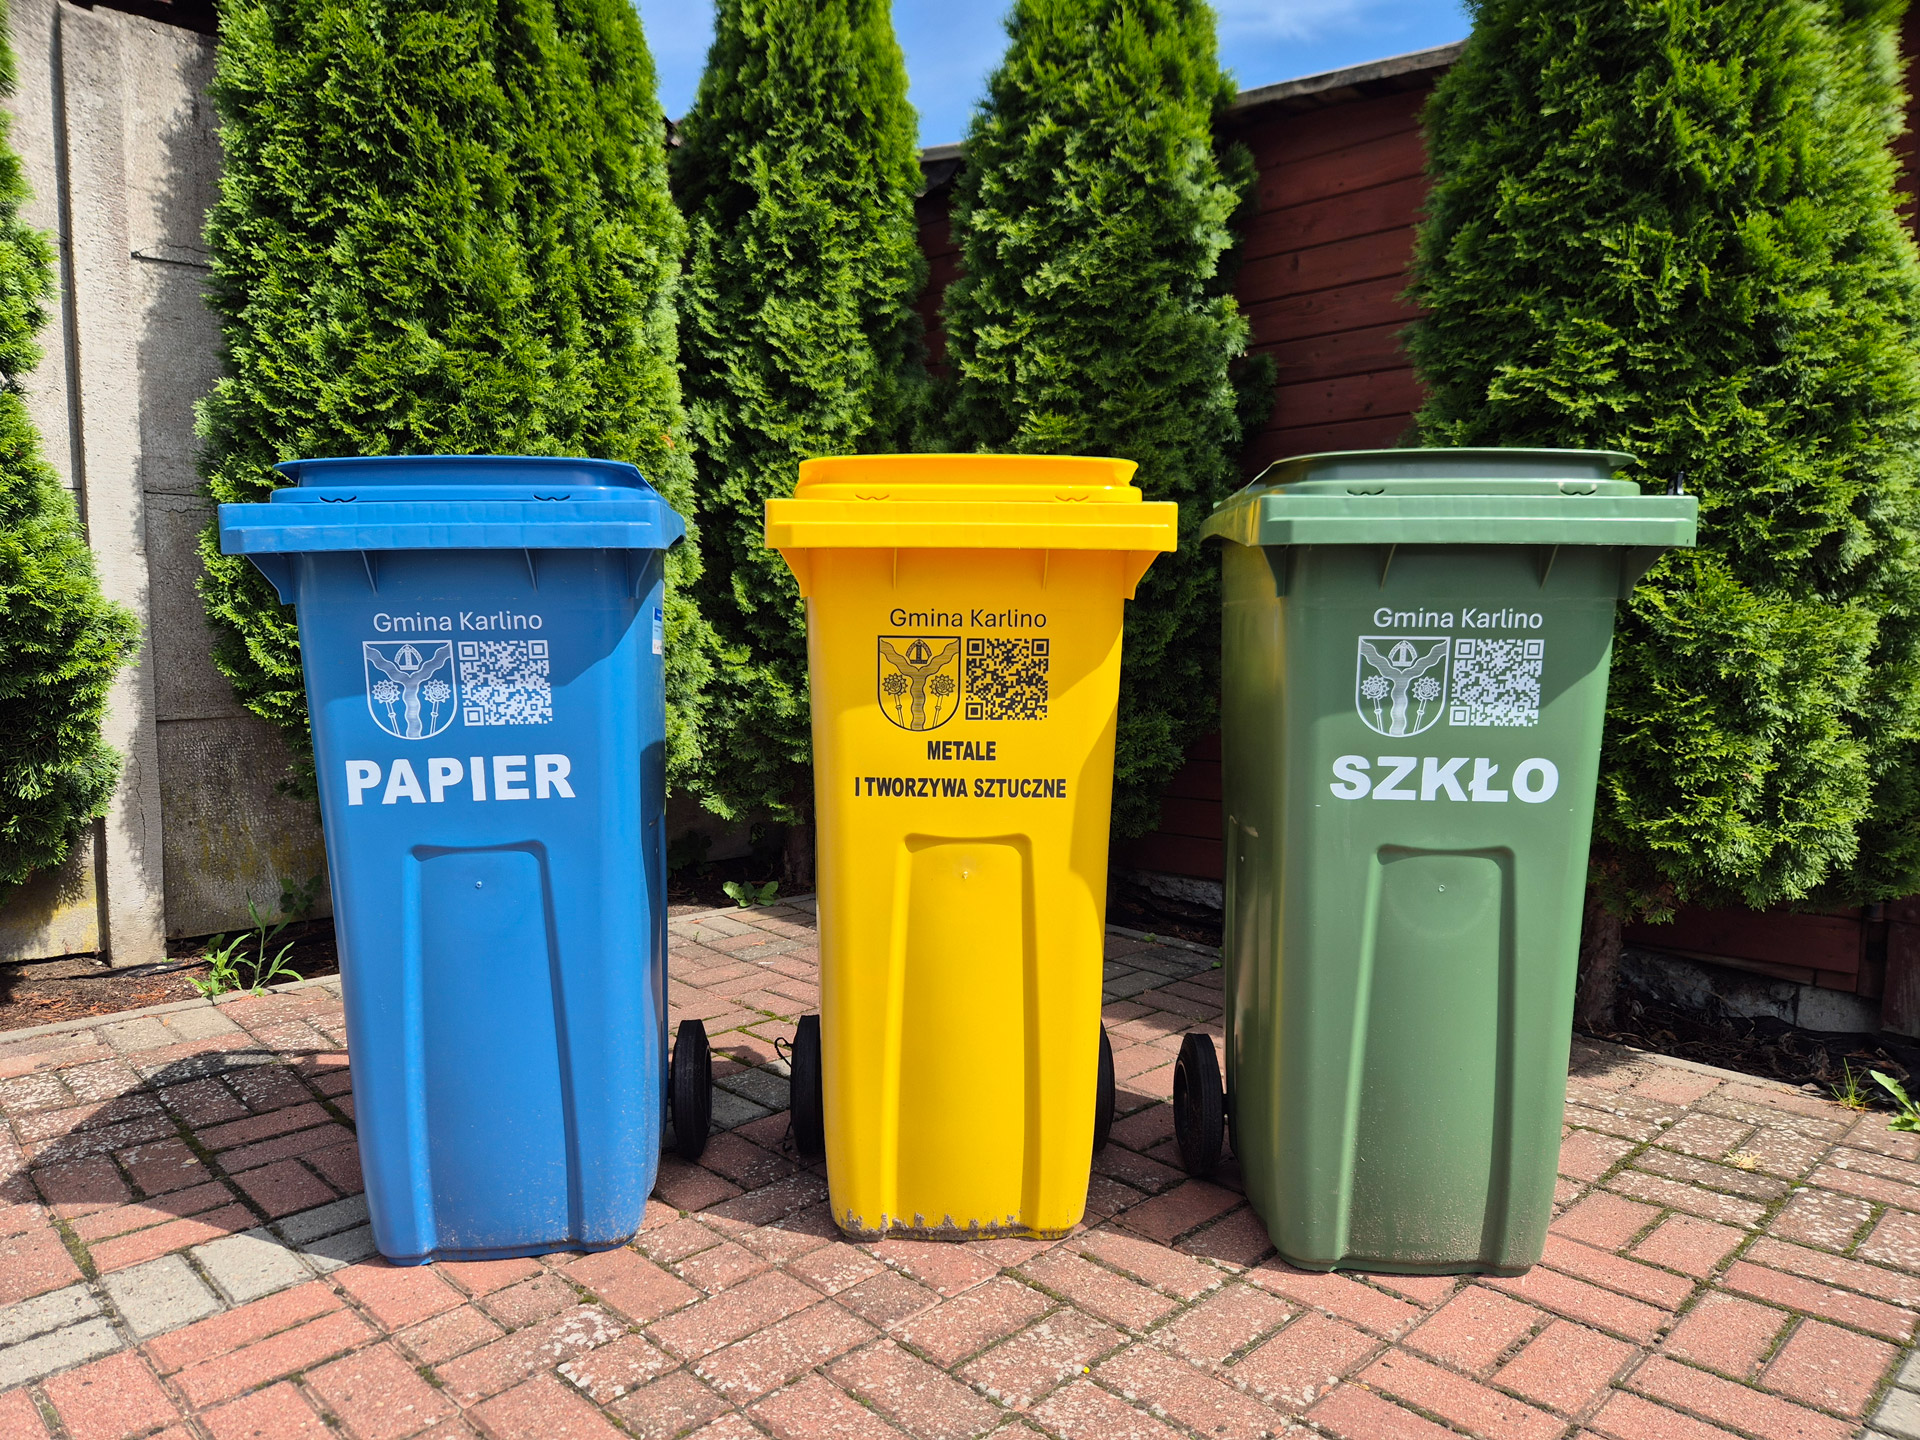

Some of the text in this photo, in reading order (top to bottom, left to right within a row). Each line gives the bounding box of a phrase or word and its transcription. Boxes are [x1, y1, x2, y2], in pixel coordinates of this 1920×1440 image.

[373, 610, 543, 633] Gmina Karlino
[890, 608, 1047, 628] Gmina Karlino
[1373, 607, 1543, 629] Gmina Karlino
[927, 740, 997, 761] METALE
[345, 753, 576, 806] PAPIER
[854, 776, 1067, 798] I TWORZYWA SZTUCZNE
[1329, 755, 1559, 804] SZKŁO
